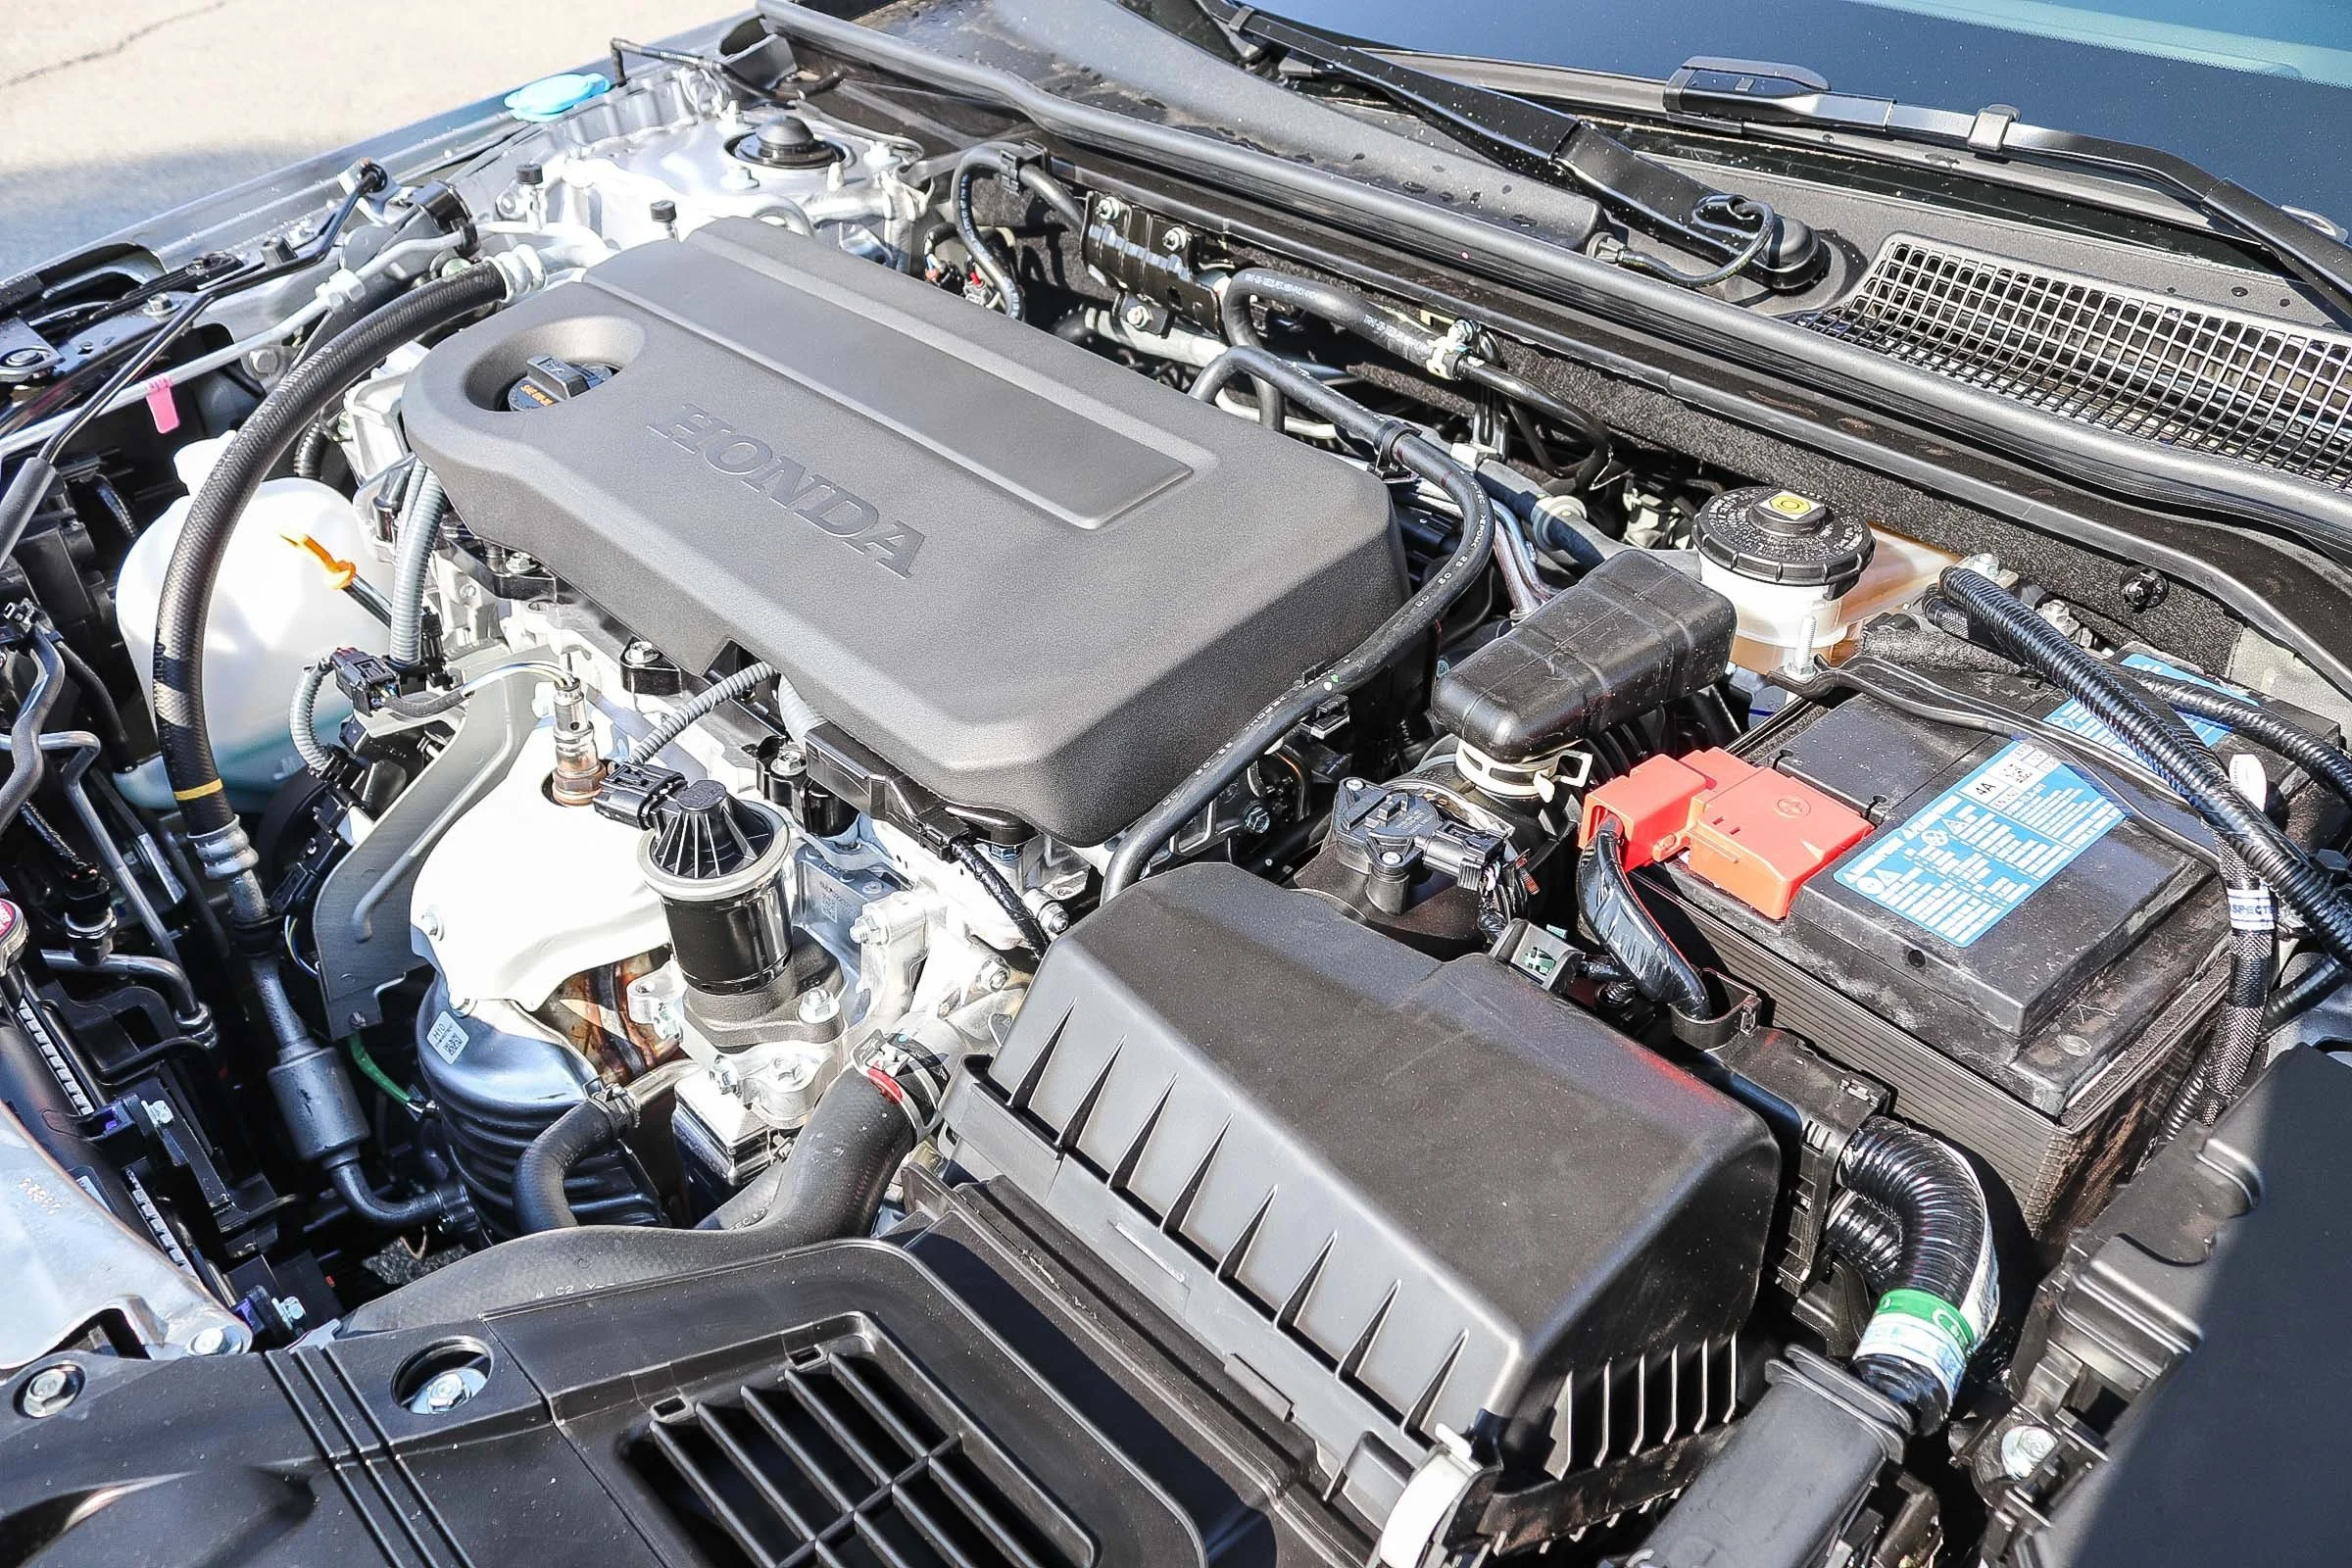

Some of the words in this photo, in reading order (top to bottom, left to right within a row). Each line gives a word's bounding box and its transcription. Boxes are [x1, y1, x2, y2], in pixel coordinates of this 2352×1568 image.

[647, 403, 925, 579] HONDA
[1438, 571, 1451, 584] 02
[1976, 782, 1997, 797] 4A
